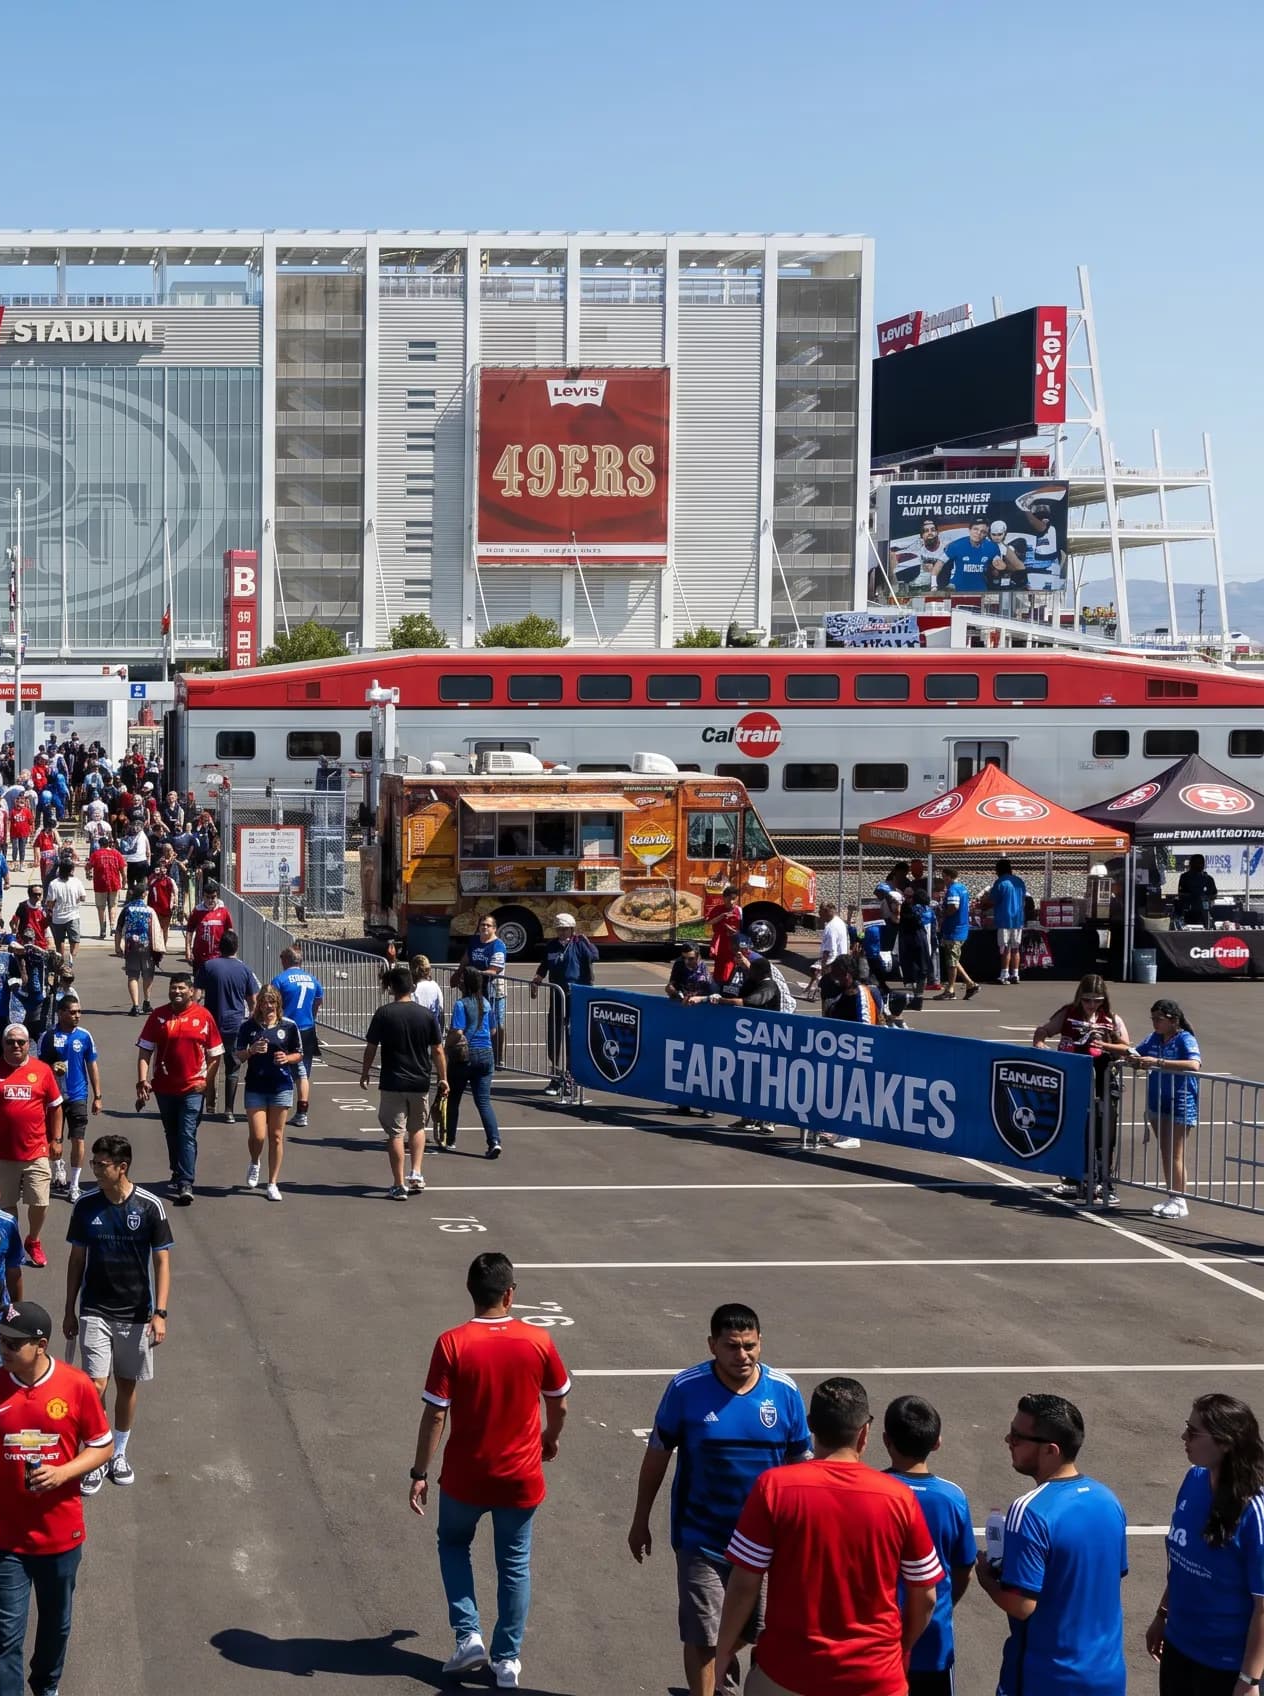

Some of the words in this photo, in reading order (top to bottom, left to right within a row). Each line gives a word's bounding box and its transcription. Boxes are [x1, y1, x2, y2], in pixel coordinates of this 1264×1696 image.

[13, 319, 153, 343] STADIUM
[492, 443, 656, 497] 49ERS
[233, 566, 256, 597] B
[702, 726, 783, 743] Caltrain
[735, 1018, 793, 1051] SAN
[800, 1028, 874, 1064] JOSE
[664, 1039, 956, 1140] EARTHQUAKES
